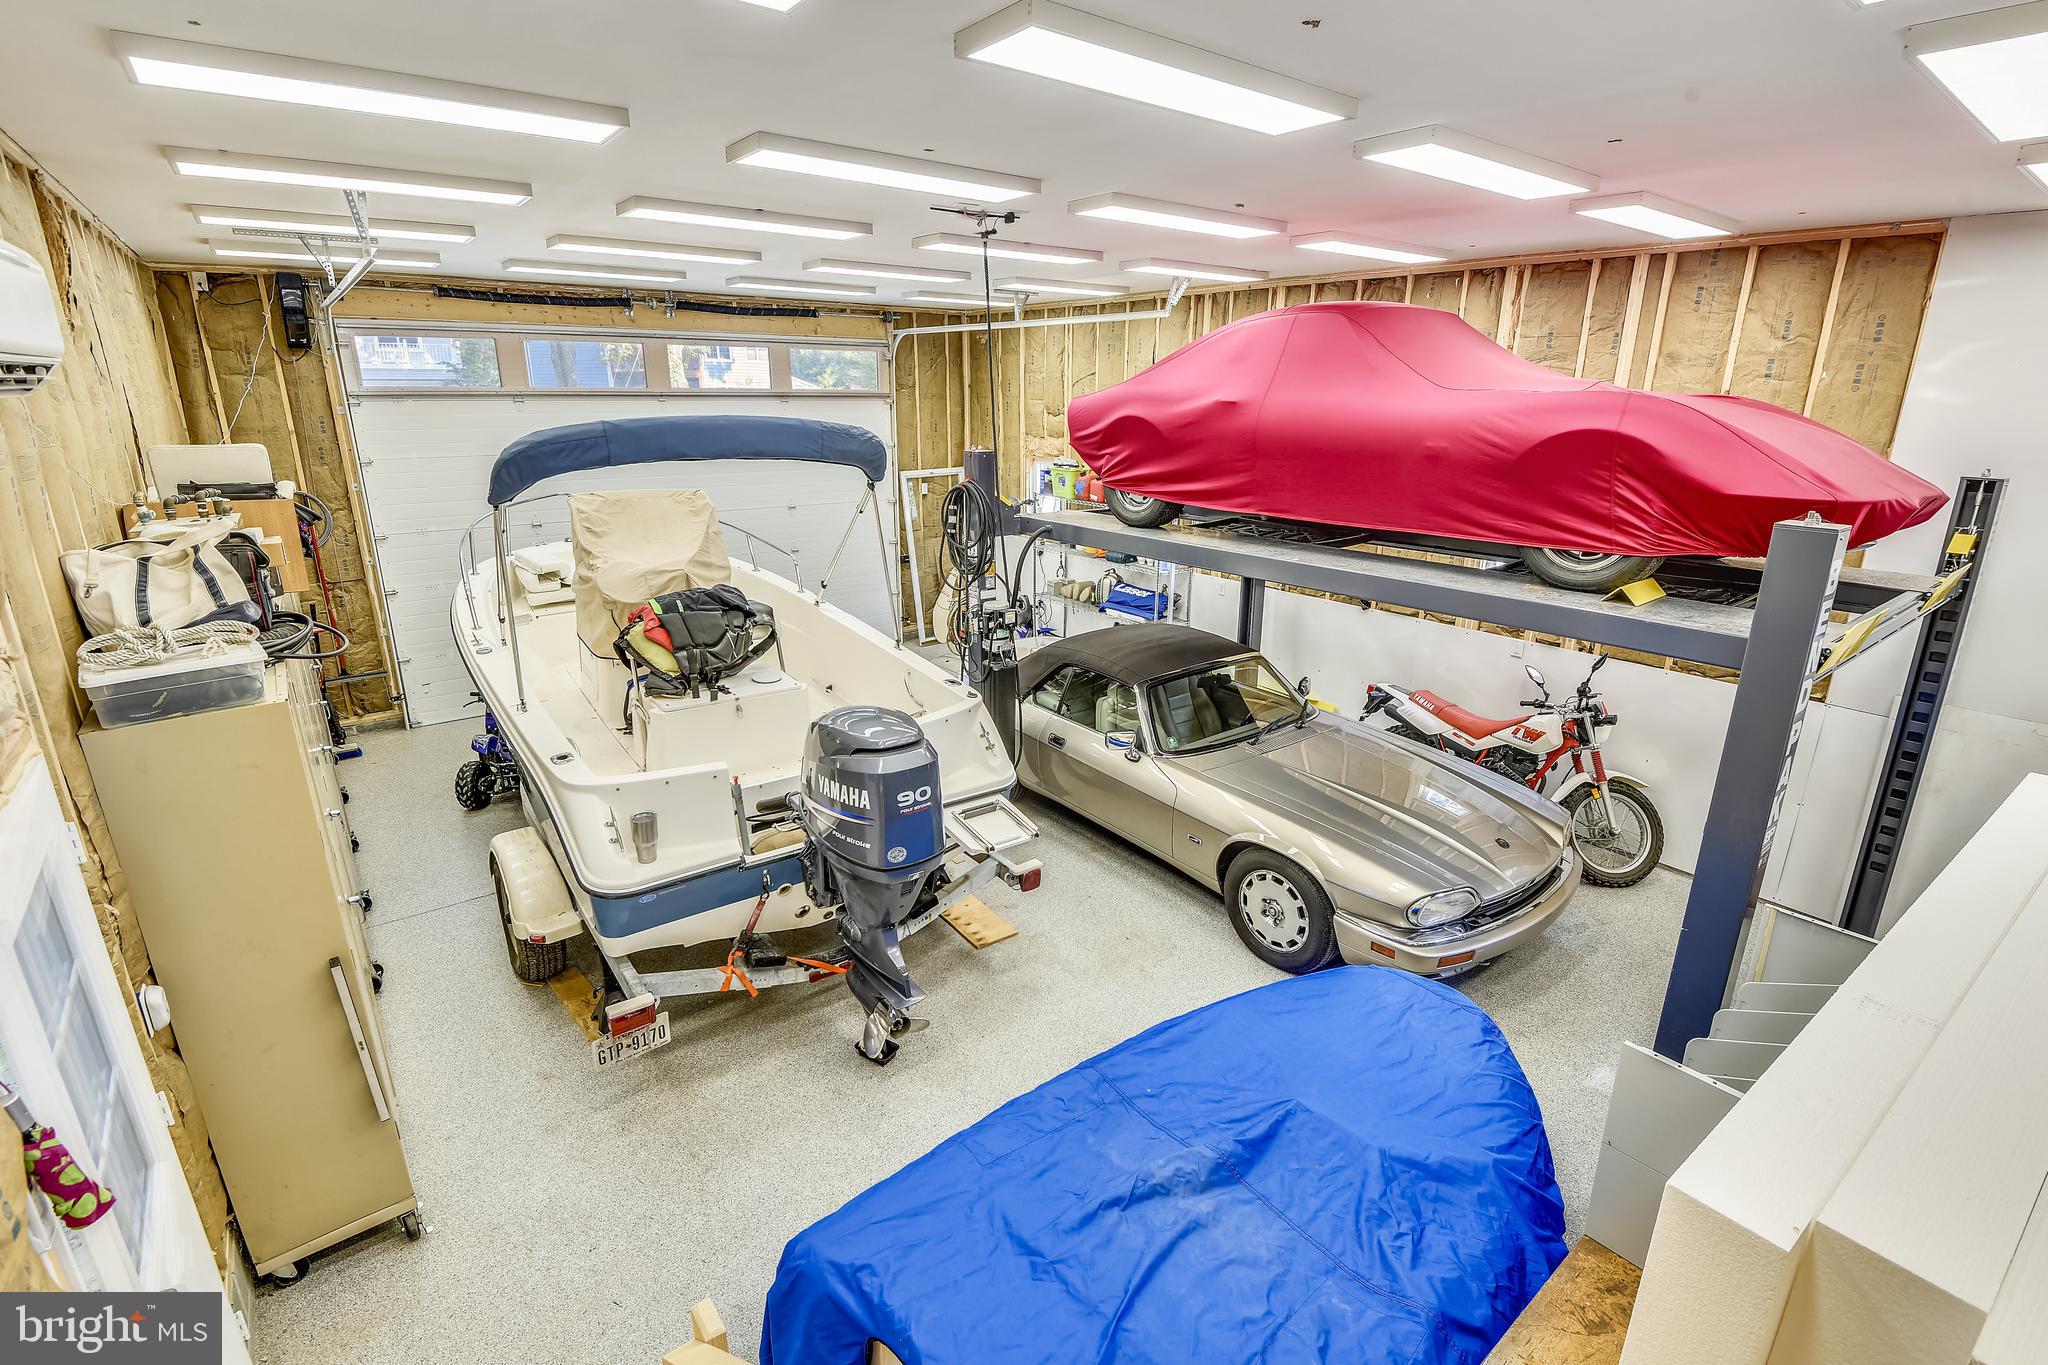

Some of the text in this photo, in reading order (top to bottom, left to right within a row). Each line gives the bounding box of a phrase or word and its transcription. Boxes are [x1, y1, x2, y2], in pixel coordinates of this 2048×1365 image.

[1413, 693, 1435, 711] YAMAHA
[1511, 724, 1547, 742] TW
[818, 774, 871, 810] YAMAHA
[896, 785, 932, 807] 90
[632, 1024, 666, 1051] 9170
